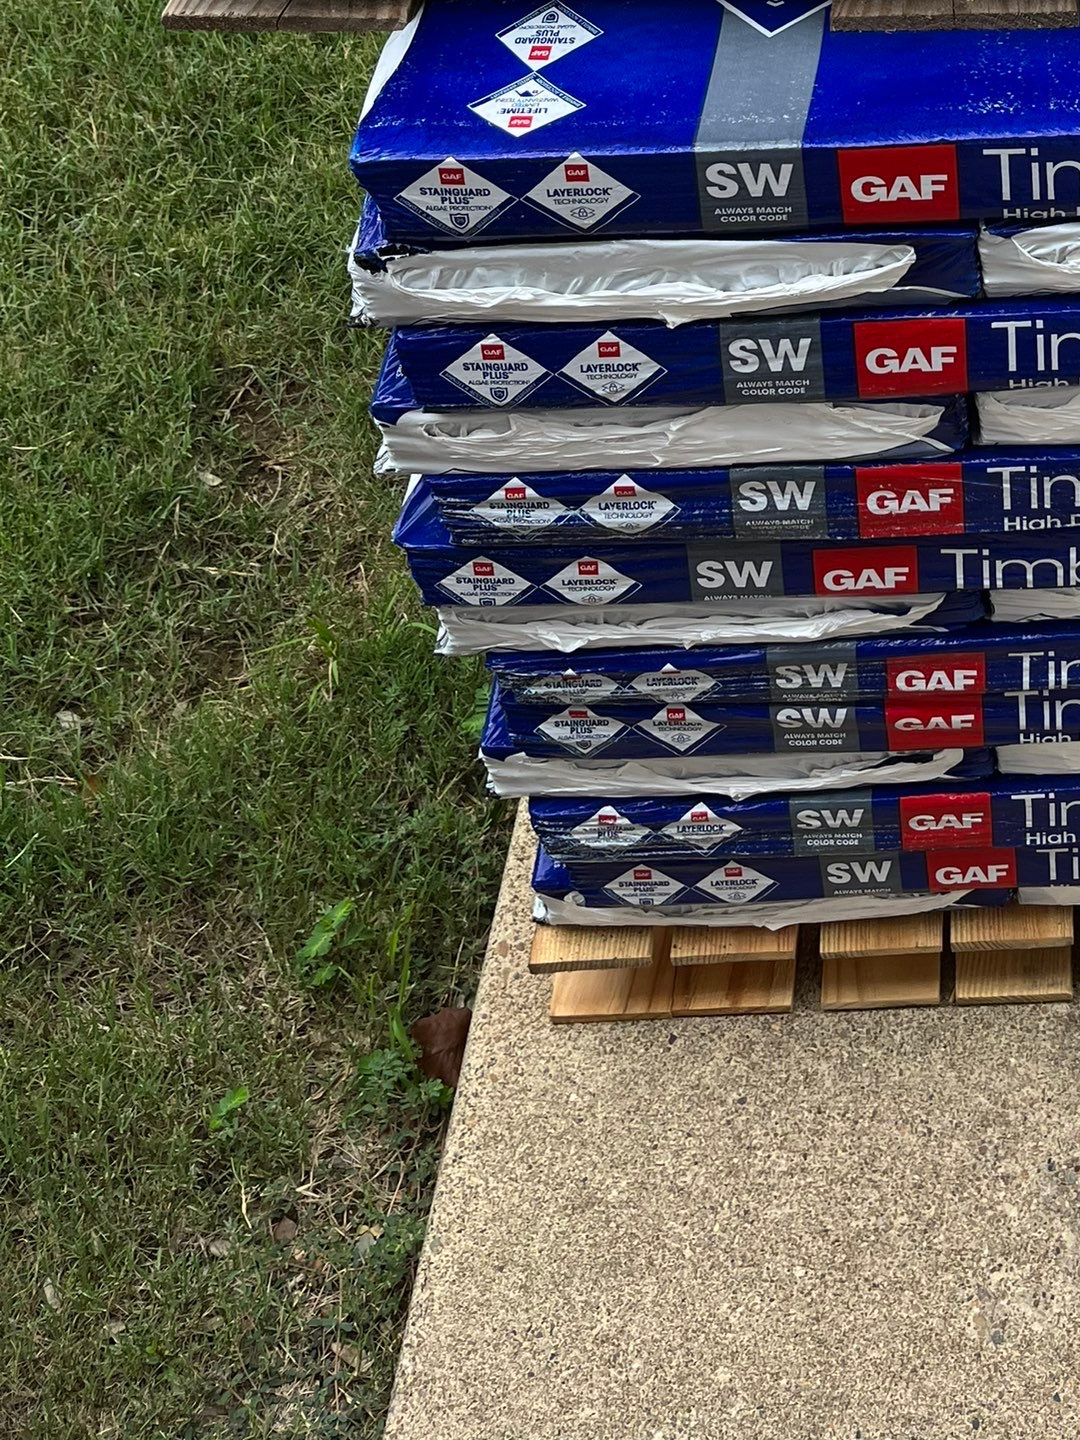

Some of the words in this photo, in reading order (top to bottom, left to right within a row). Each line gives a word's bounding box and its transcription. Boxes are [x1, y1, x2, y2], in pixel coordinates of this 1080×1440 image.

[706, 162, 794, 199] SW
[850, 174, 949, 204] GAF
[419, 187, 490, 197] STAINGUARD
[441, 196, 470, 205] PLUS
[546, 187, 608, 198] LAYERLOCK
[552, 197, 609, 205] TECHNOLOGY
[714, 207, 753, 216] ALWAYS
[756, 205, 793, 215] MATCH
[720, 214, 757, 223] COLOR
[760, 213, 788, 222] CODE
[727, 337, 812, 374] SW
[865, 346, 958, 375] GAF
[738, 480, 817, 513] SW
[866, 487, 955, 516] GAF
[696, 560, 774, 588] SW
[823, 566, 910, 591] GAF
[775, 662, 849, 690] SW
[895, 670, 978, 692] GAF
[776, 707, 848, 729] SW
[797, 808, 864, 830] SW
[908, 812, 985, 832] GAF
[1025, 831, 1063, 846] High
[827, 860, 893, 885] SW
[935, 863, 1010, 885] GAF
